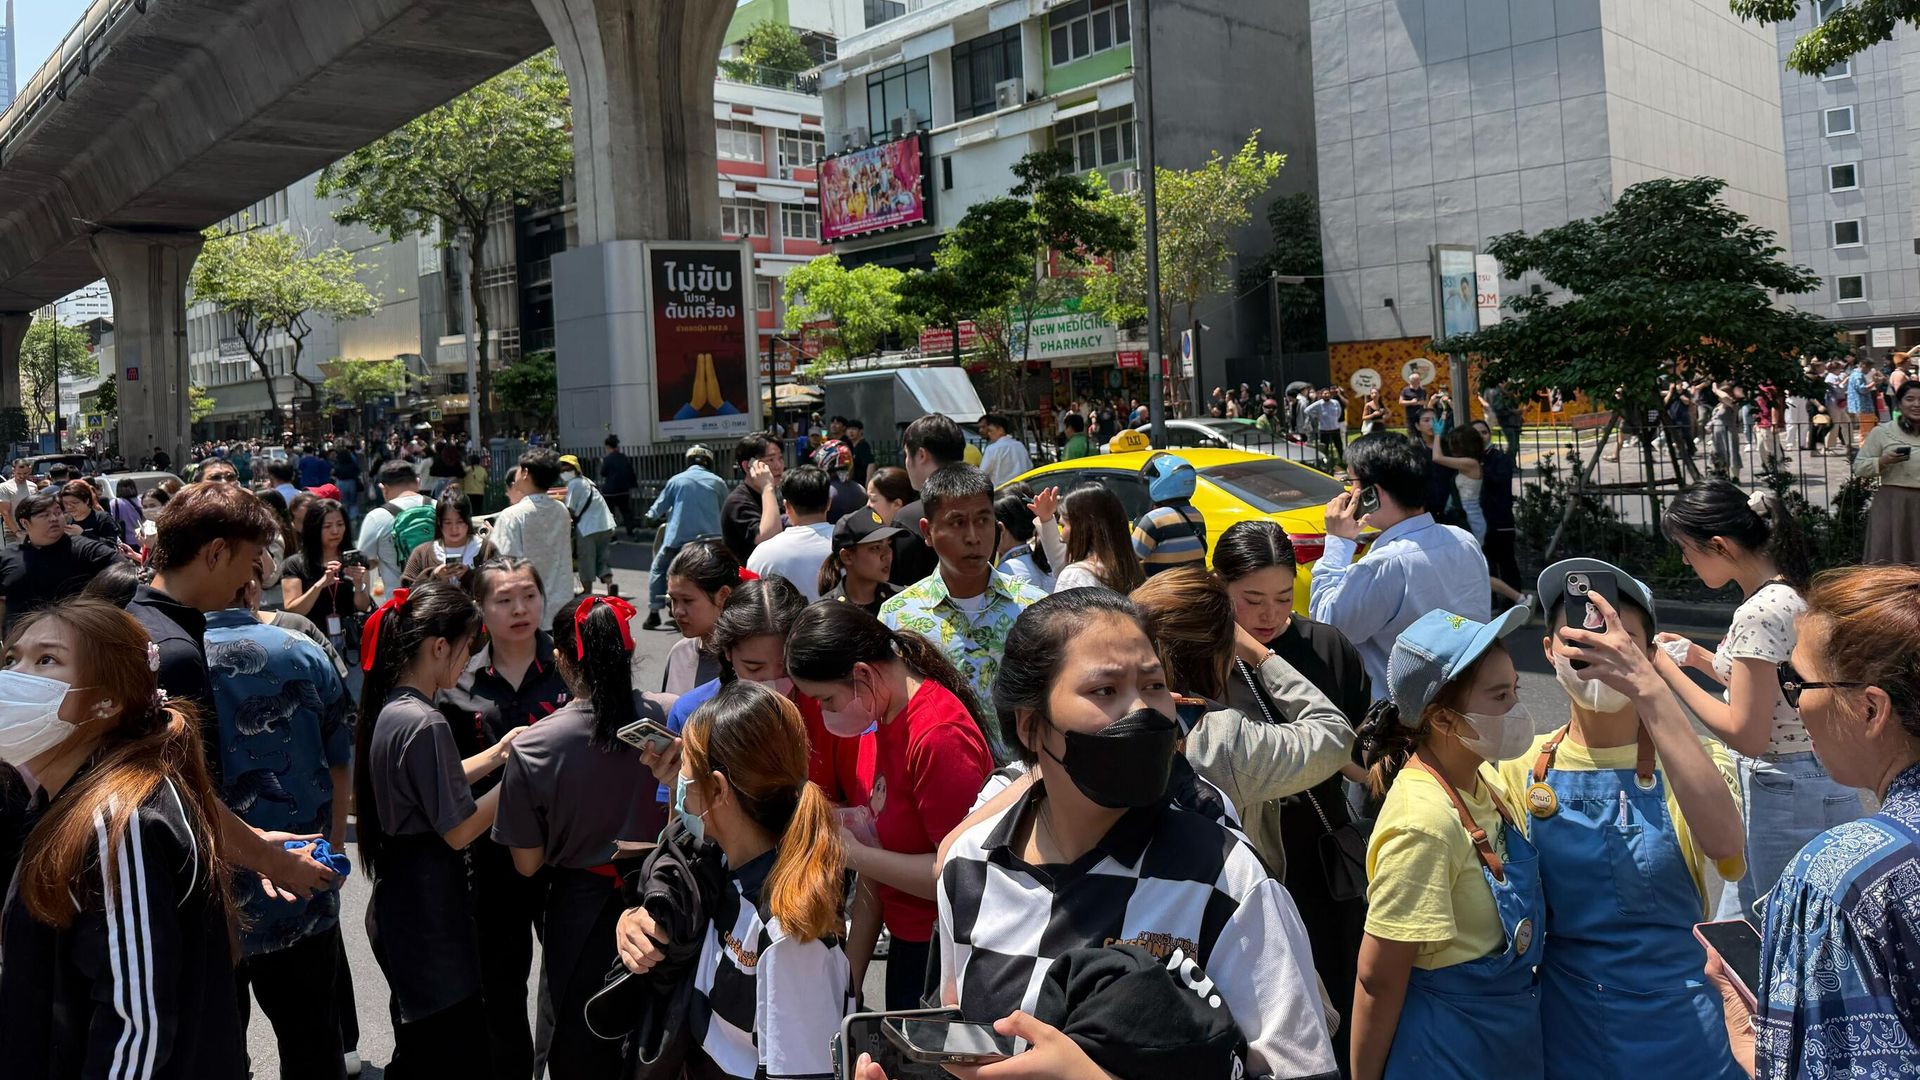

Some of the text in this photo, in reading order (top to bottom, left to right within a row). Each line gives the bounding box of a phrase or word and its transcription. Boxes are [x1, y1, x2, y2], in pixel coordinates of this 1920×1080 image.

[664, 261, 732, 292] ไม่ขับ
[1478, 274, 1490, 282] TSU
[683, 292, 706, 303] โปรด
[1478, 293, 1497, 304] OM
[665, 298, 736, 319] ดับเครื่อง
[1032, 316, 1110, 336] NEW MEDICINE
[1041, 335, 1102, 352] PHARMACY
